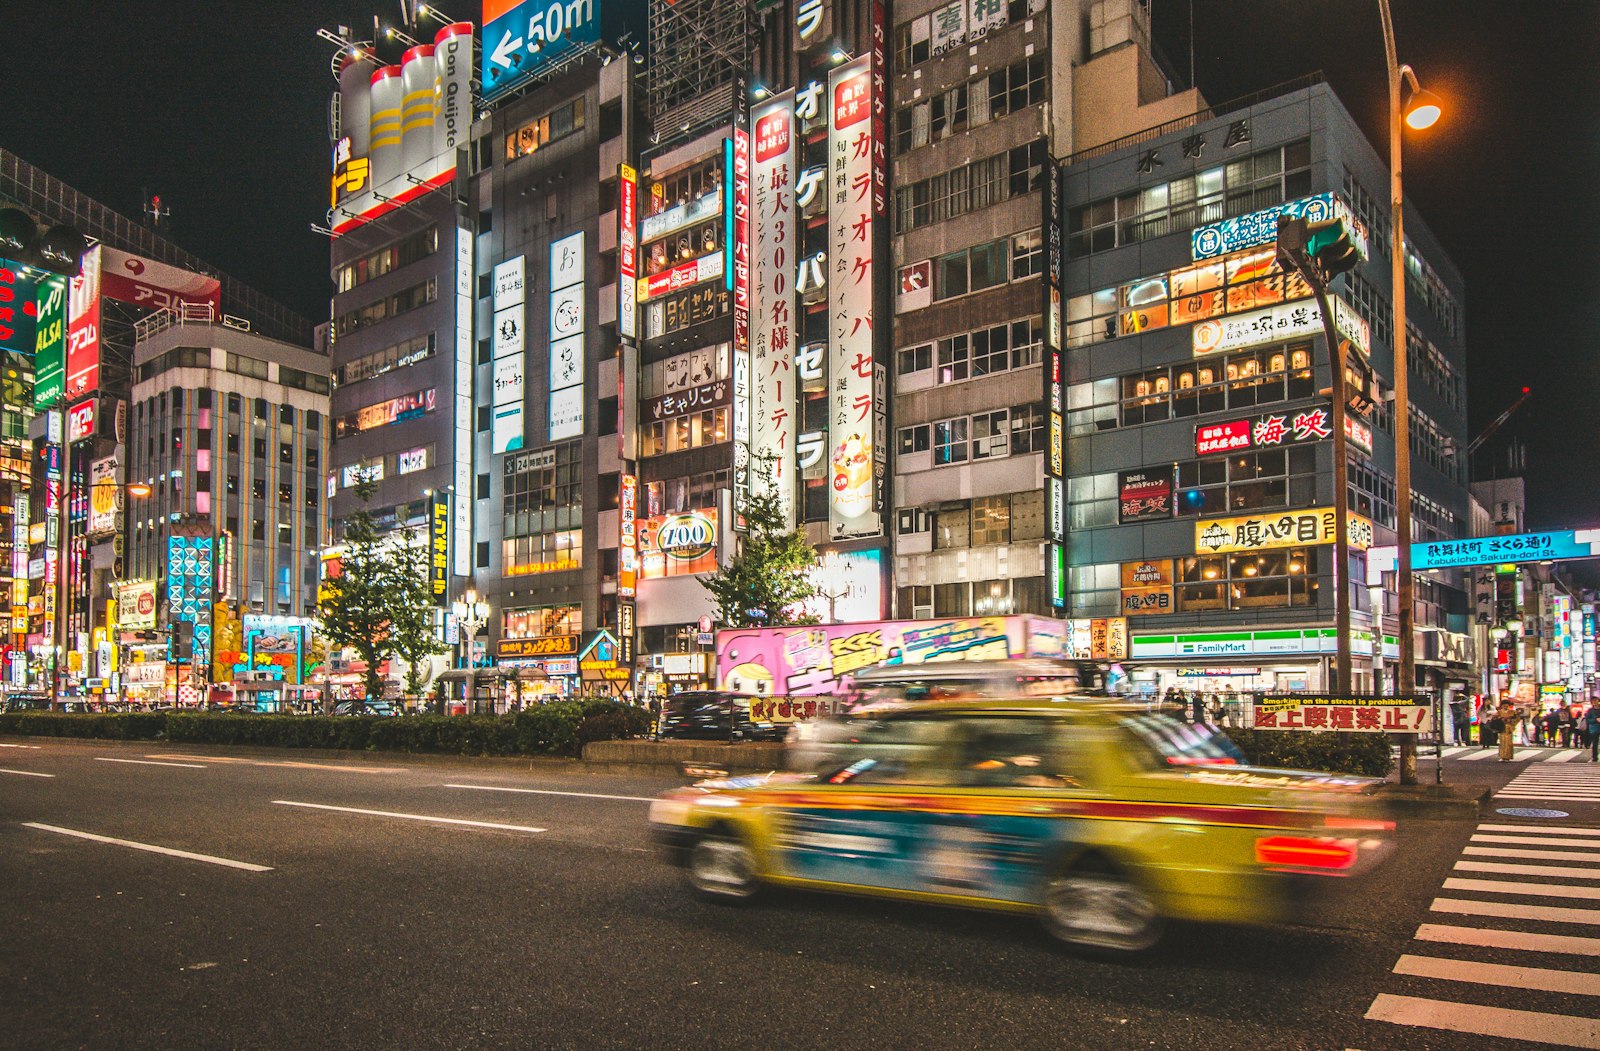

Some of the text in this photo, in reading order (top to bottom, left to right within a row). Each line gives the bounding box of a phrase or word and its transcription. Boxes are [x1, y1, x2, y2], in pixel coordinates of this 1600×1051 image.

[527, 0, 593, 53] 50m
[445, 40, 459, 148] Don Quijote
[35, 319, 61, 353] ALSA
[69, 323, 97, 354] アコム
[662, 387, 713, 415] きゃりこ
[664, 524, 707, 547] ZOO
[1234, 514, 1318, 547] 腹八分目
[1427, 535, 1552, 557] 歌舞伎町 さくら通り
[1427, 549, 1558, 566] Kabukicho Sakura-dori St.
[1197, 643, 1246, 653] FamilyMart
[1314, 697, 1329, 705] the
[1331, 698, 1357, 706] street
[1368, 698, 1416, 707] prohibited.
